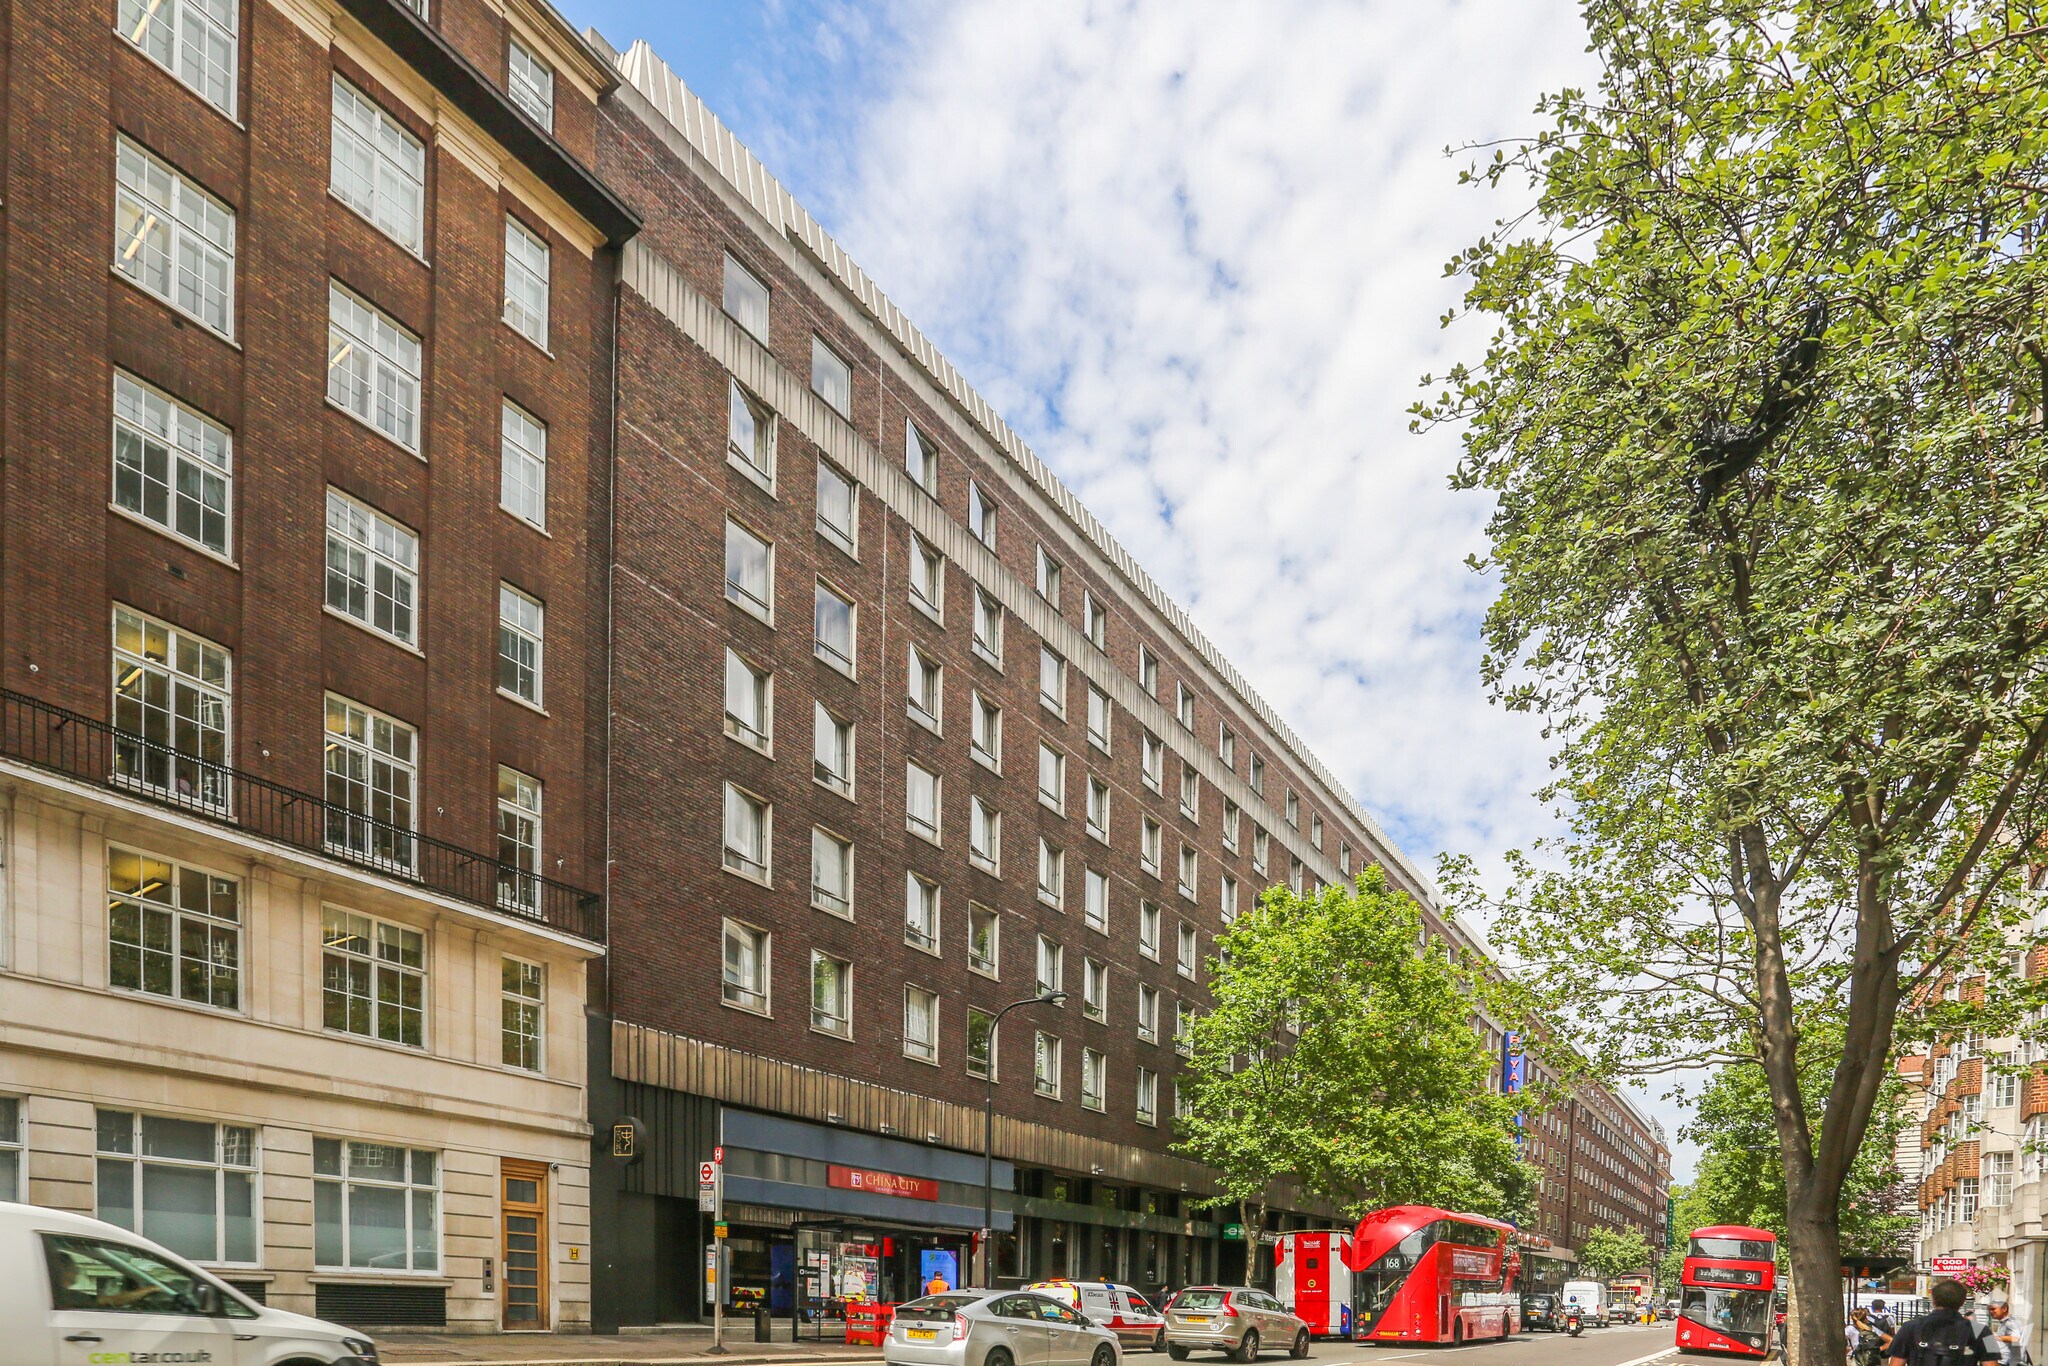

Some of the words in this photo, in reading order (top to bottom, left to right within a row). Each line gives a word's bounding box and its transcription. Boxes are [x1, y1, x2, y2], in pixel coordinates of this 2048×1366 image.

[865, 1174, 897, 1189] CHINA
[899, 1179, 921, 1192] CITY
[1386, 1258, 1400, 1268] 168
[1745, 1272, 1755, 1282] 91
